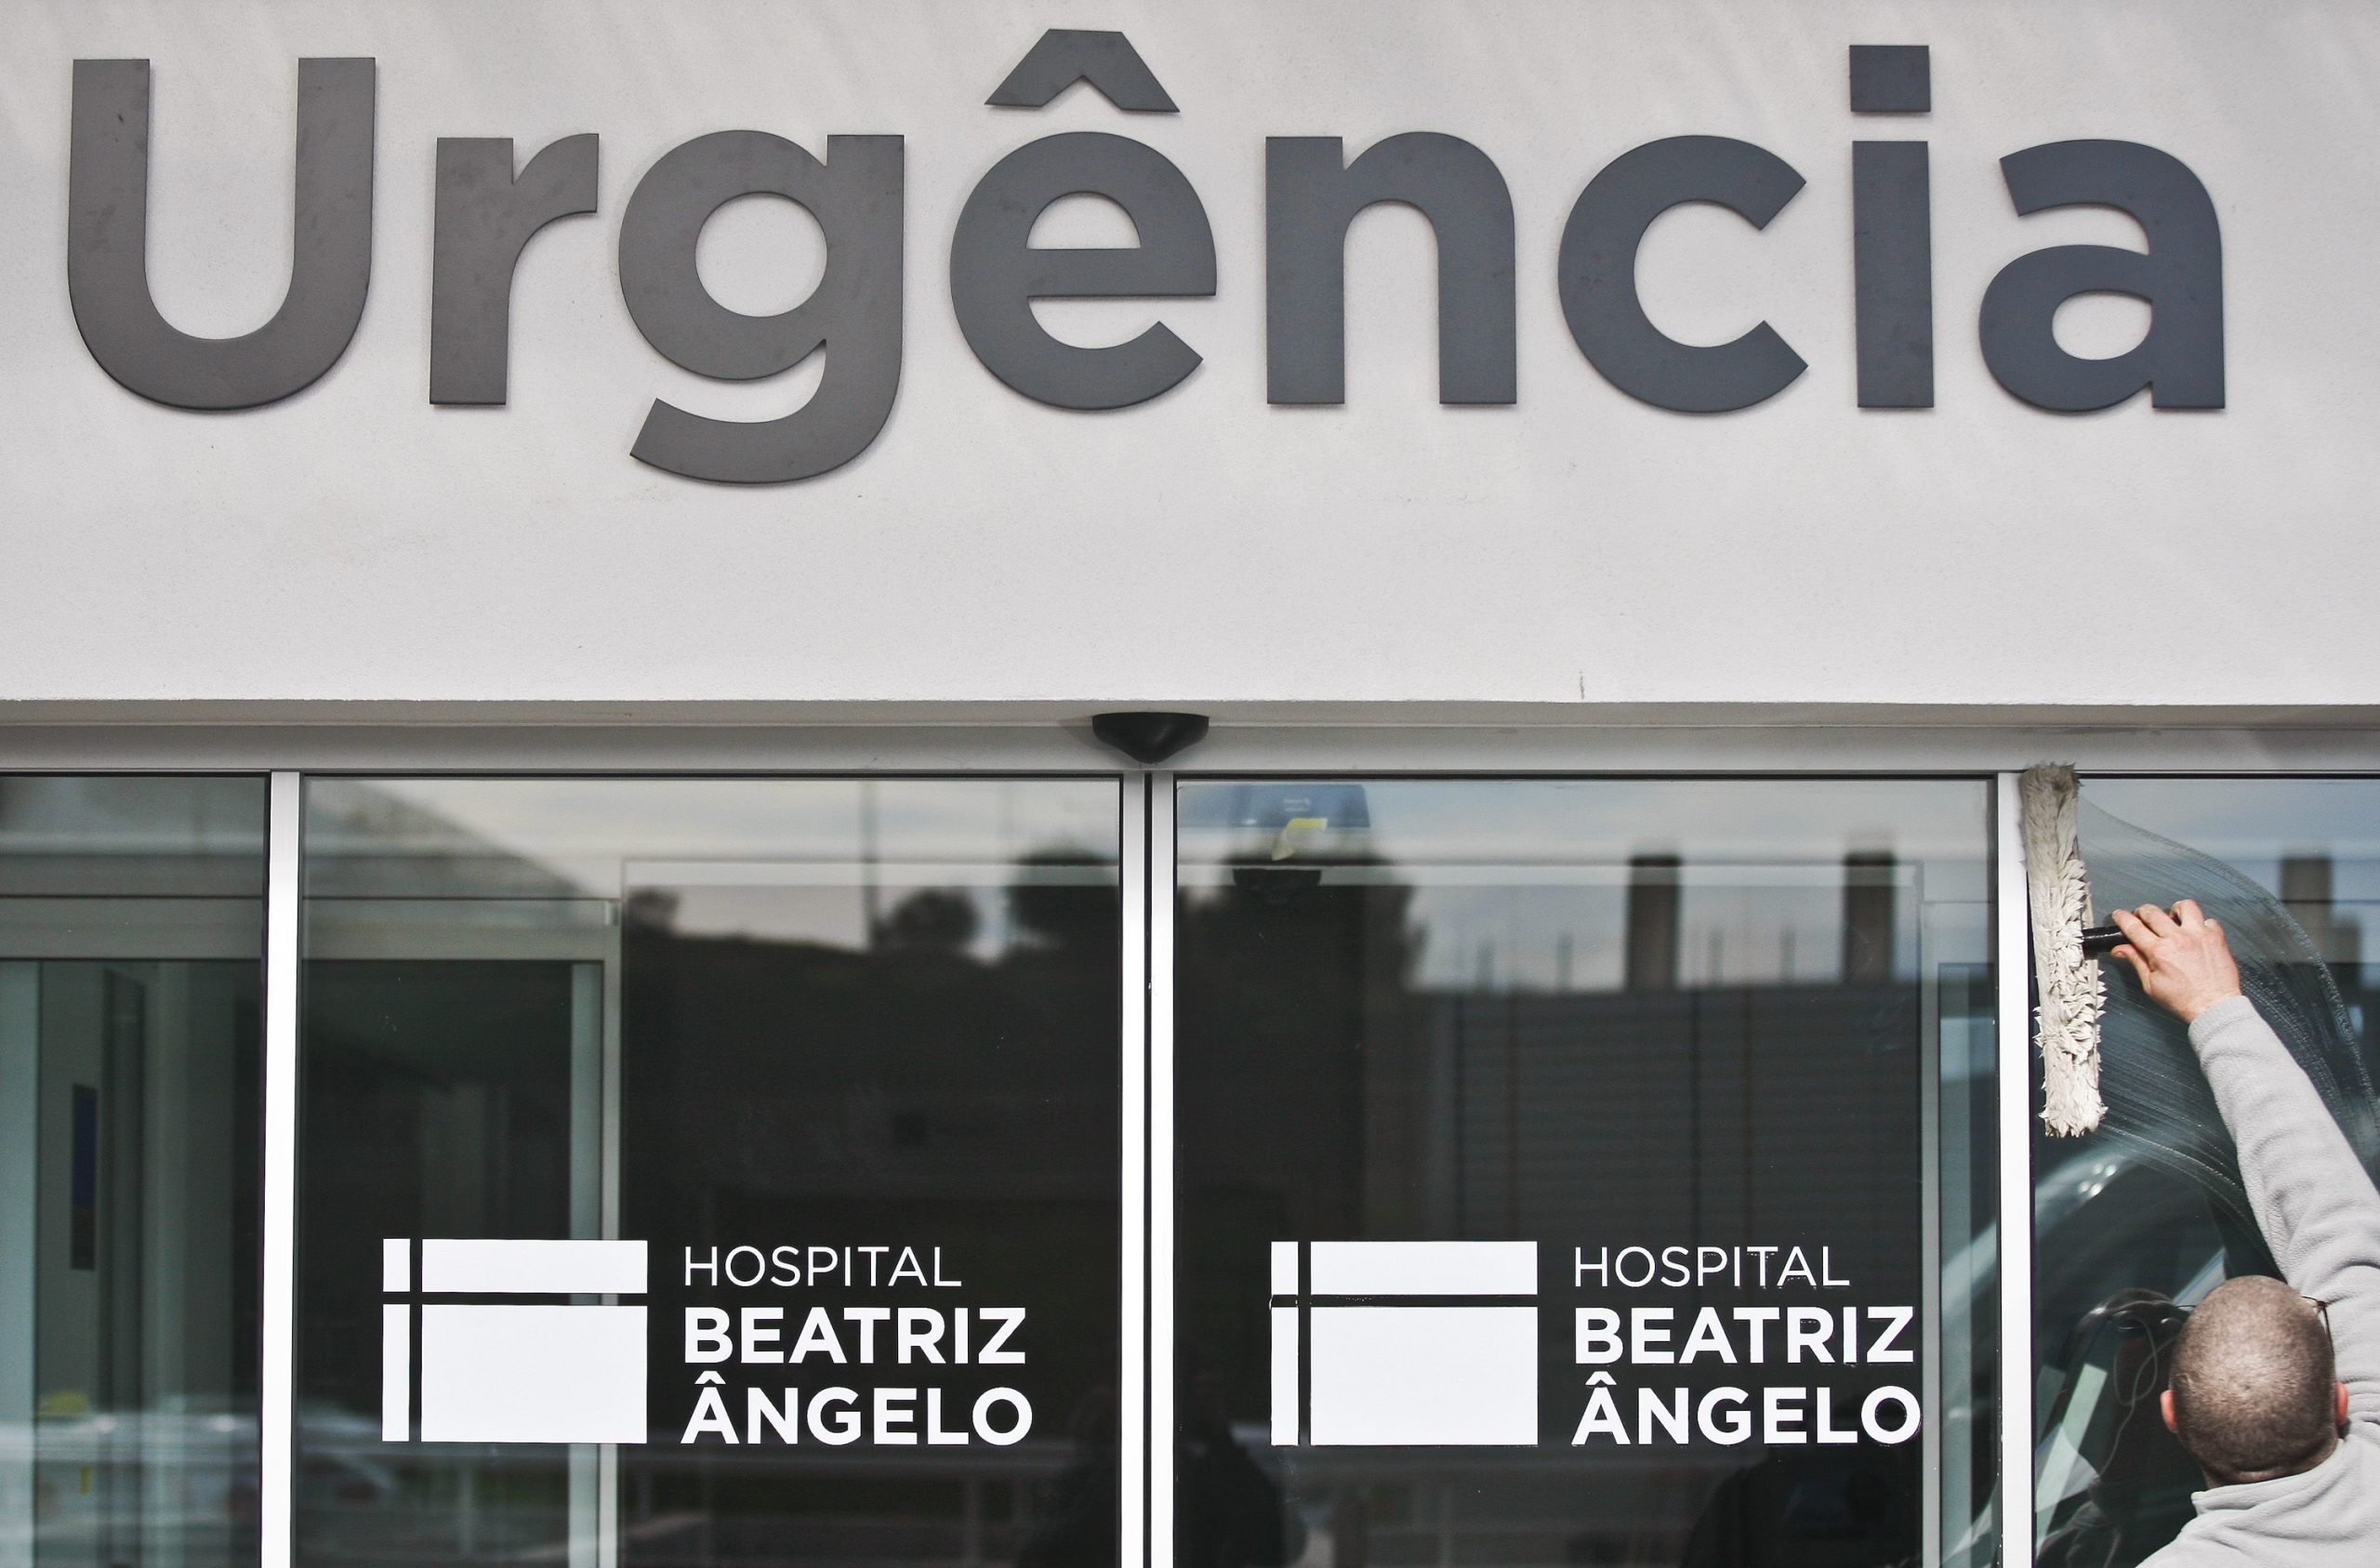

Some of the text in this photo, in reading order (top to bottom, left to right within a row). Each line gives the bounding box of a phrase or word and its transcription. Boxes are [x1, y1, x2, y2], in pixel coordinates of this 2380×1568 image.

[67, 28, 2228, 489] Urgência
[684, 1245, 962, 1287] HOSPITAL
[1575, 1245, 1851, 1287] HOSPITAL
[684, 1307, 1026, 1364] BEATRIZ
[1575, 1306, 1914, 1364] BEATRIZ
[681, 1370, 1033, 1446] ÂNGELO
[1571, 1371, 1922, 1445] ÂNGELO
